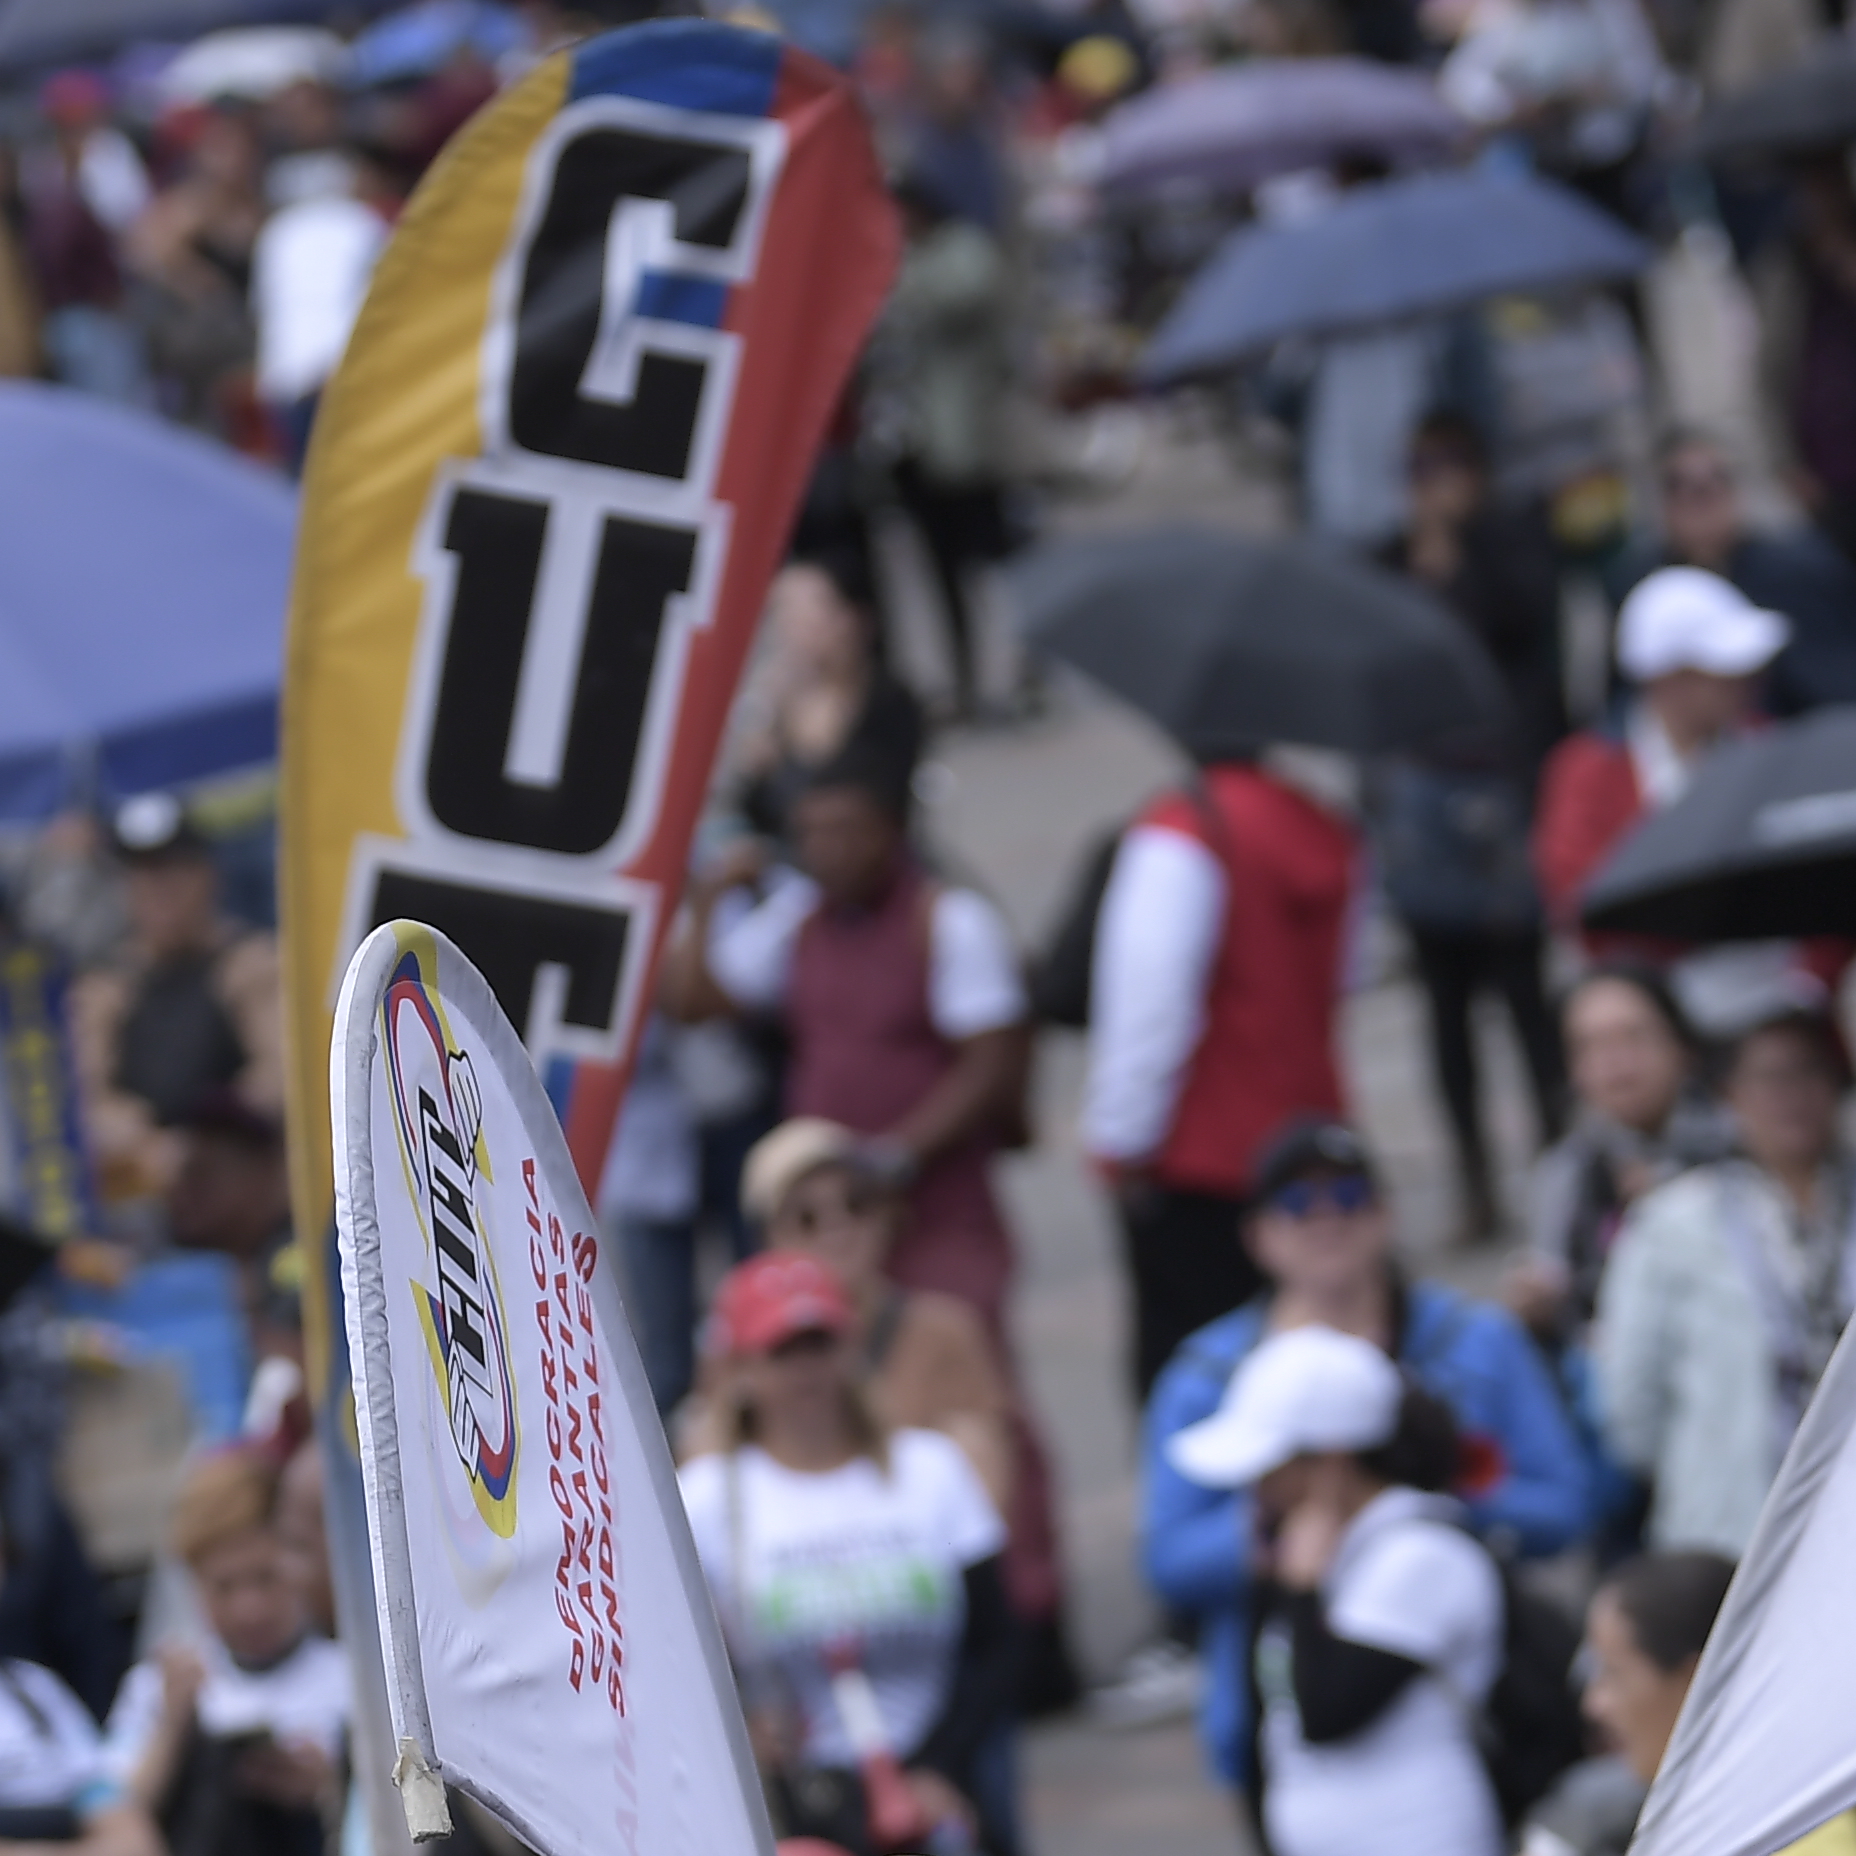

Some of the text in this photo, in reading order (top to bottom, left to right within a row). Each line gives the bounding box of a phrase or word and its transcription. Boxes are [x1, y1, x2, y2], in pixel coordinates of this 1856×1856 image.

[520, 1157, 585, 1694] DEMOCRACIA
[546, 1211, 605, 1684] GARANTIAS
[571, 1231, 626, 1718] SINDICALES
